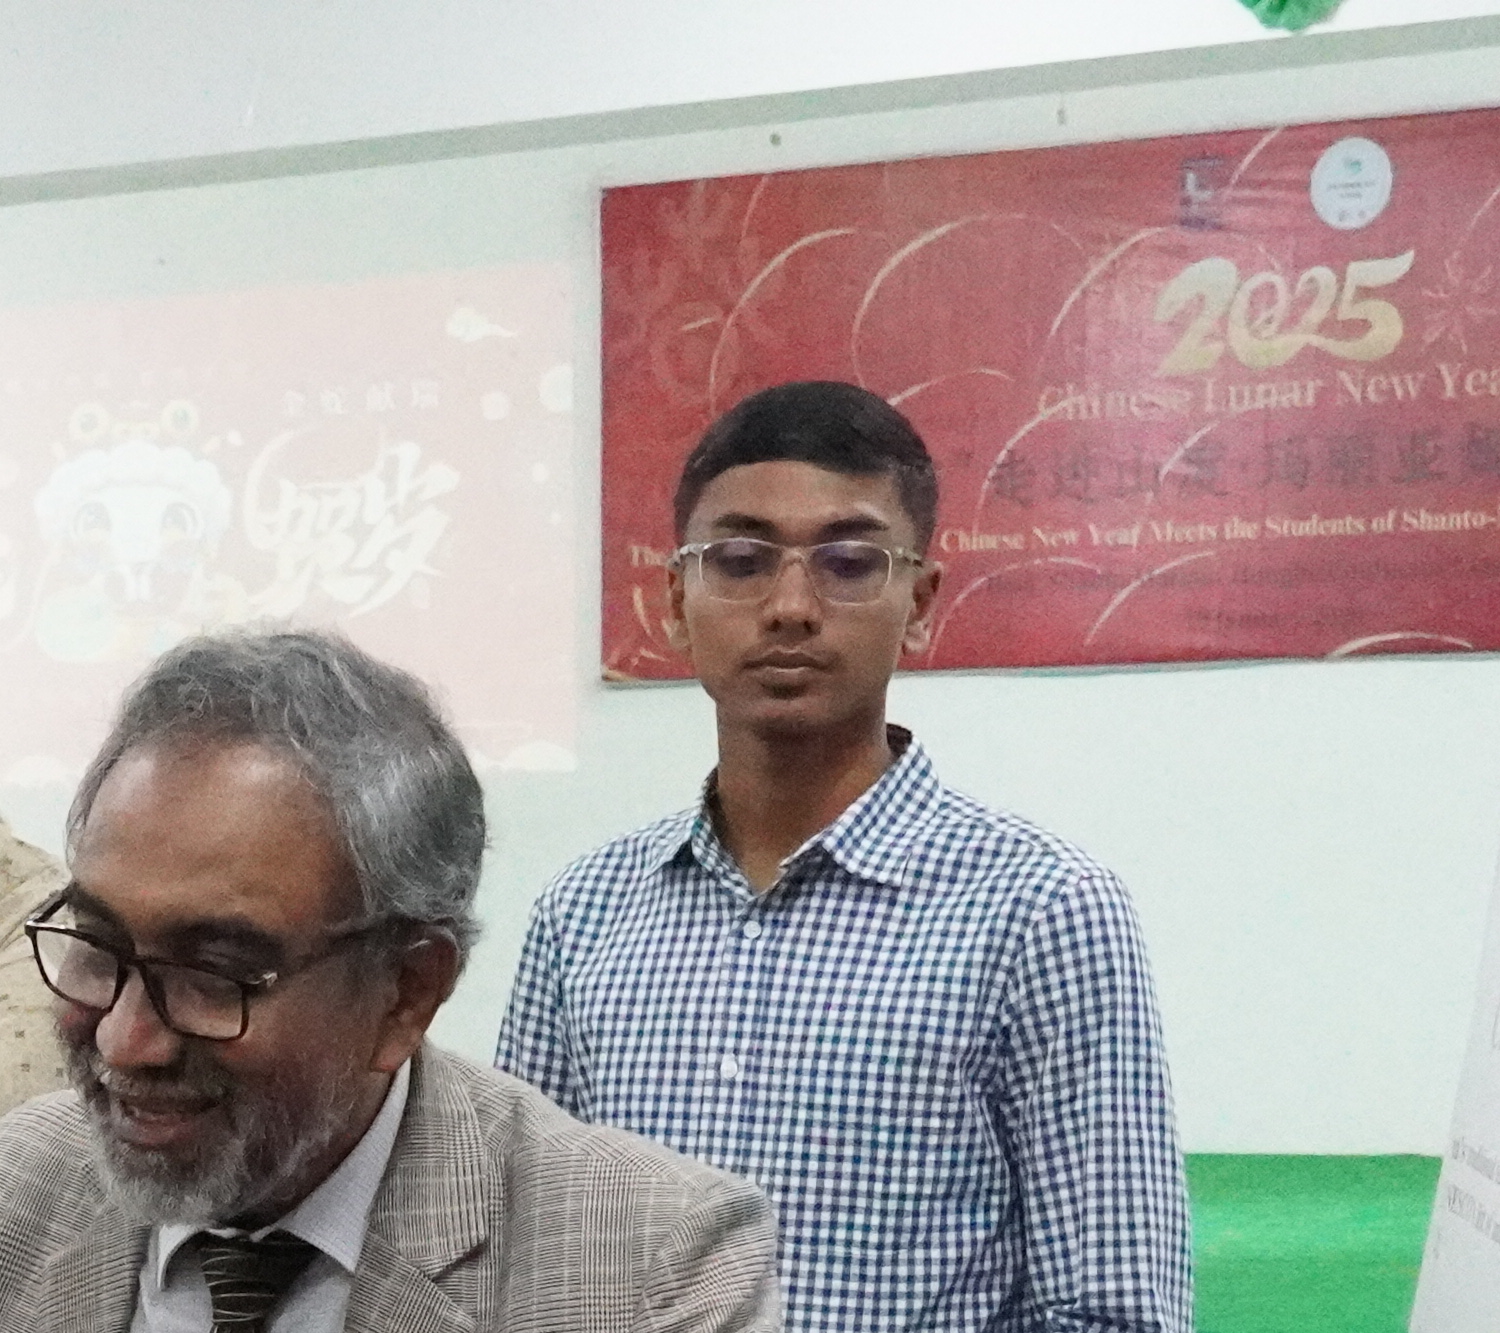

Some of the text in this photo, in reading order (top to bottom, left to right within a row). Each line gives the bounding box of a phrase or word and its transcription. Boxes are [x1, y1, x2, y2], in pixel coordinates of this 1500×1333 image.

[1152, 249, 1415, 378] 2025
[1036, 382, 1192, 422] Chinese
[1205, 374, 1323, 415] Lunar
[1336, 367, 1425, 405] New
[939, 524, 1024, 554] Chinese
[1031, 523, 1081, 551] New
[1085, 521, 1141, 549] Year
[1147, 517, 1216, 545] Meets
[1223, 515, 1260, 541] the
[1264, 508, 1367, 539] Students
[1371, 507, 1398, 533] of
